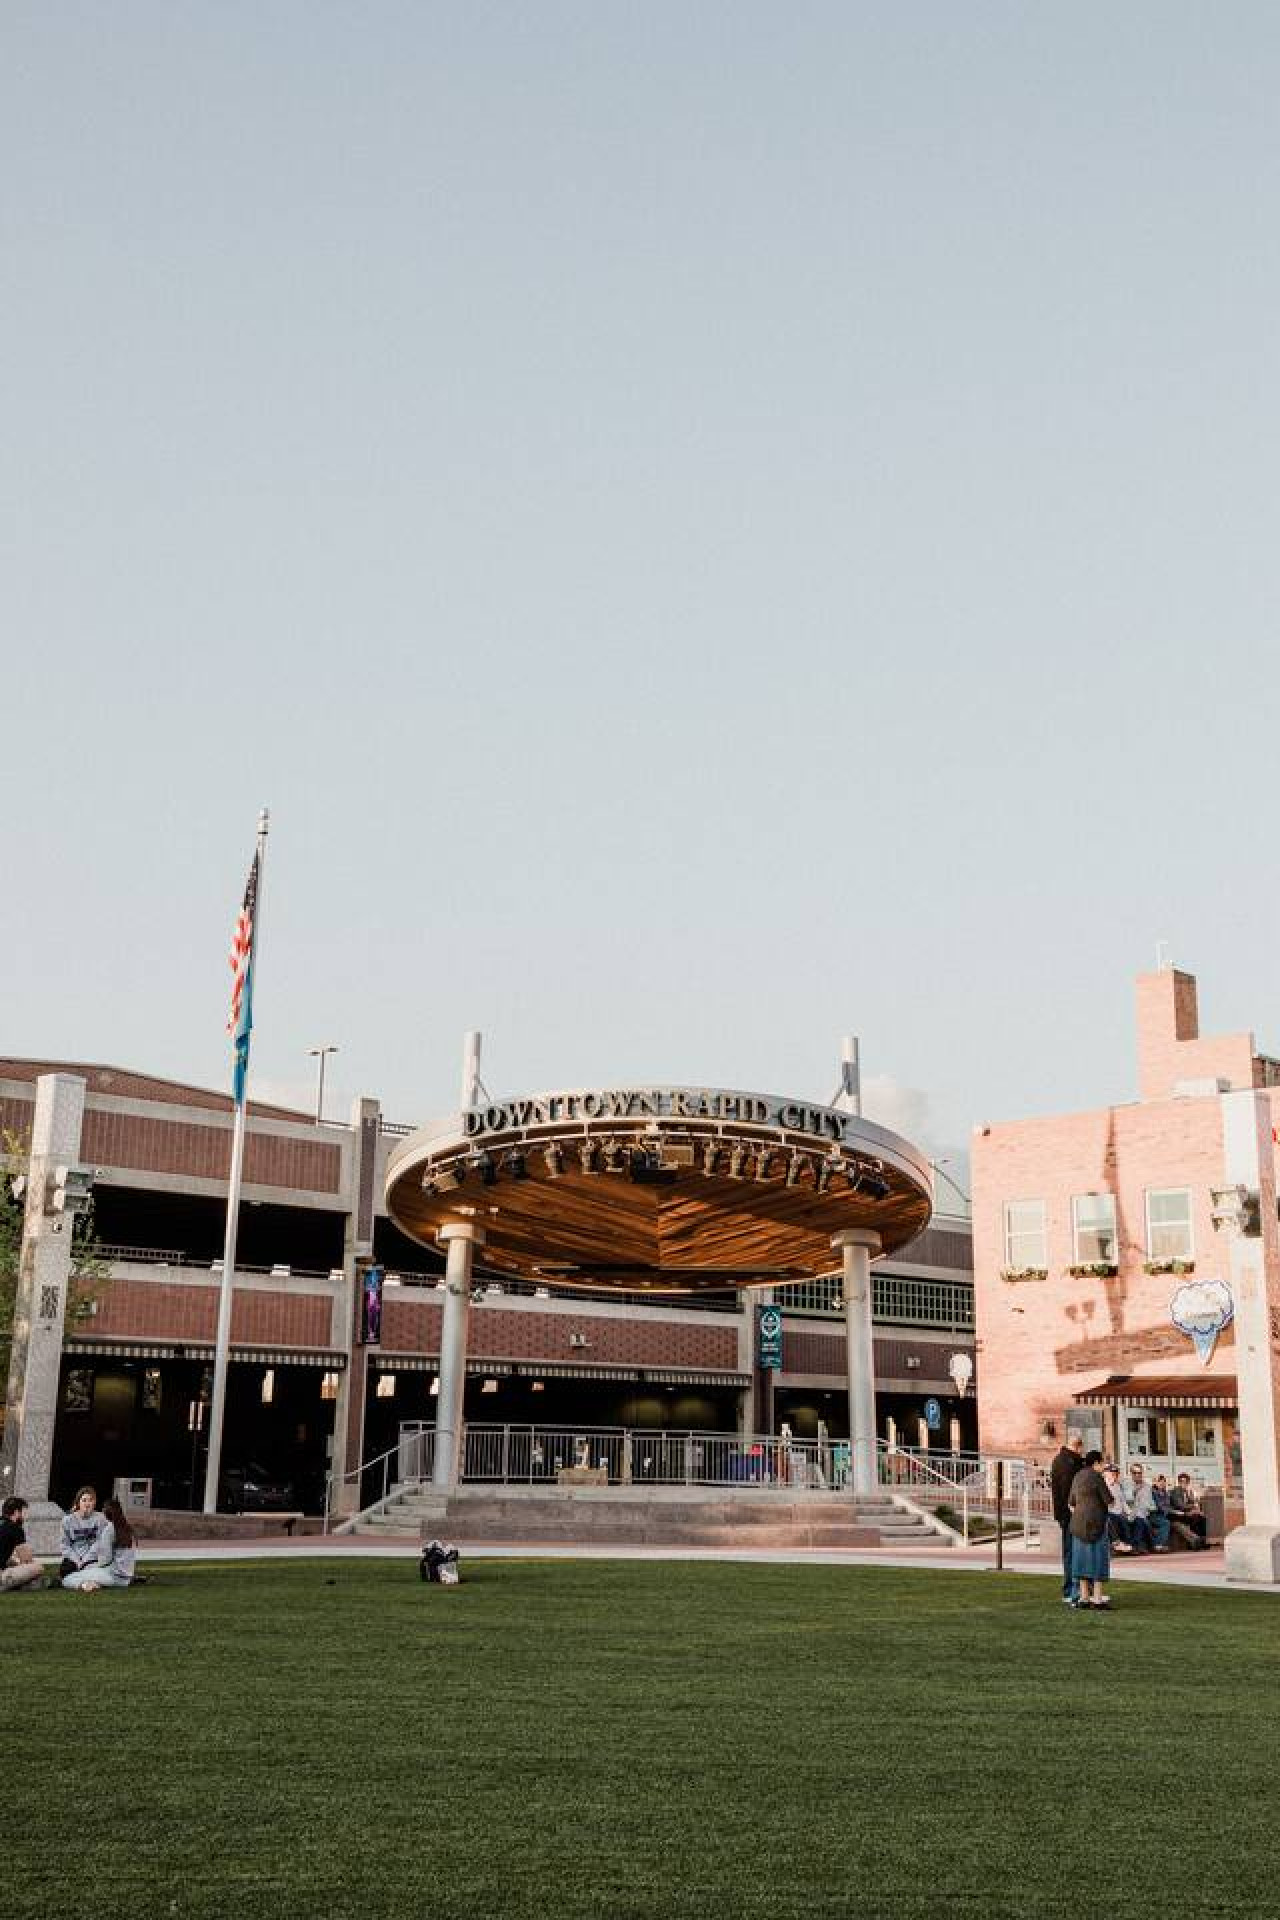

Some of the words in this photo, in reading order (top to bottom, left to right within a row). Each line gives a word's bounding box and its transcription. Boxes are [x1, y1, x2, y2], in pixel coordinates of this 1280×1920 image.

[463, 1091, 661, 1137] DOWNTOWN
[669, 1091, 771, 1122] RAPID
[777, 1103, 848, 1140] CITY
